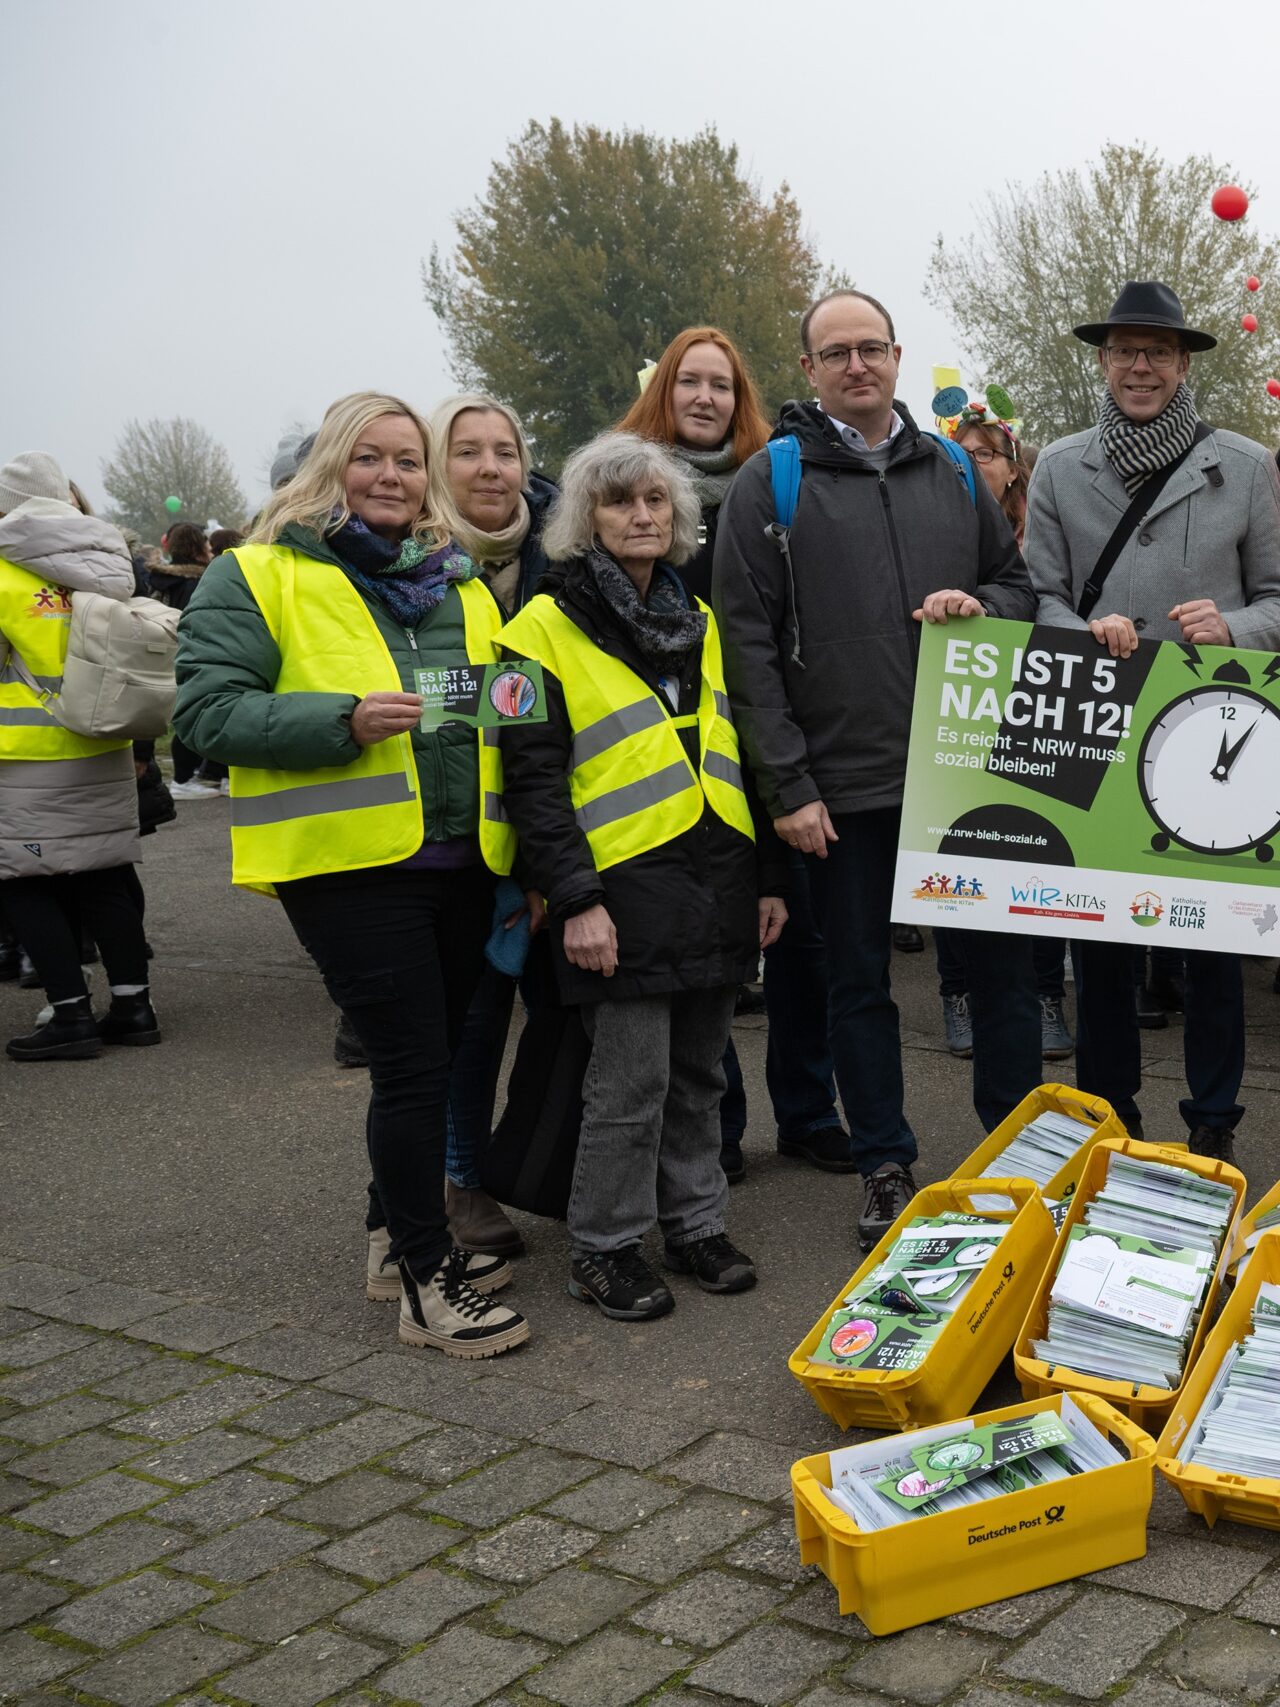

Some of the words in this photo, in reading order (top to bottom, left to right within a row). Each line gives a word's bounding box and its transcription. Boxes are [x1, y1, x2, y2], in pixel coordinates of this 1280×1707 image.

[944, 638, 1000, 679] ES
[1011, 647, 1084, 689] IST
[1091, 657, 1117, 693] 5
[418, 672, 436, 683] ES
[438, 670, 459, 682] IST
[461, 669, 470, 680] 5
[421, 682, 458, 695] NACH
[460, 680, 478, 692] 12!
[939, 682, 1066, 731] NACH
[1077, 700, 1134, 739] 12!
[1219, 706, 1236, 721] 12
[936, 726, 958, 744] Es
[962, 731, 1012, 750] reicht
[1032, 737, 1076, 757] NRW
[1079, 746, 1126, 763] muss
[934, 751, 985, 769] sozial
[988, 753, 1056, 777] bleiben!
[927, 825, 1048, 846] www.nrw-bleib-sozial.de
[1171, 897, 1207, 906] Katholische
[1170, 905, 1206, 918] KITAS
[1169, 917, 1205, 930] RUHR
[942, 1212, 958, 1220] ES
[970, 1298, 995, 1335] Deutsche
[992, 1280, 1005, 1299] Post
[1020, 1428, 1063, 1444] NACH
[1048, 1434, 1067, 1443] ES
[998, 1441, 1020, 1451] 12!
[1010, 1446, 1020, 1454] 5
[1023, 1439, 1047, 1450] IST
[968, 1525, 1017, 1546] Deutsche
[1019, 1516, 1042, 1531] Post
